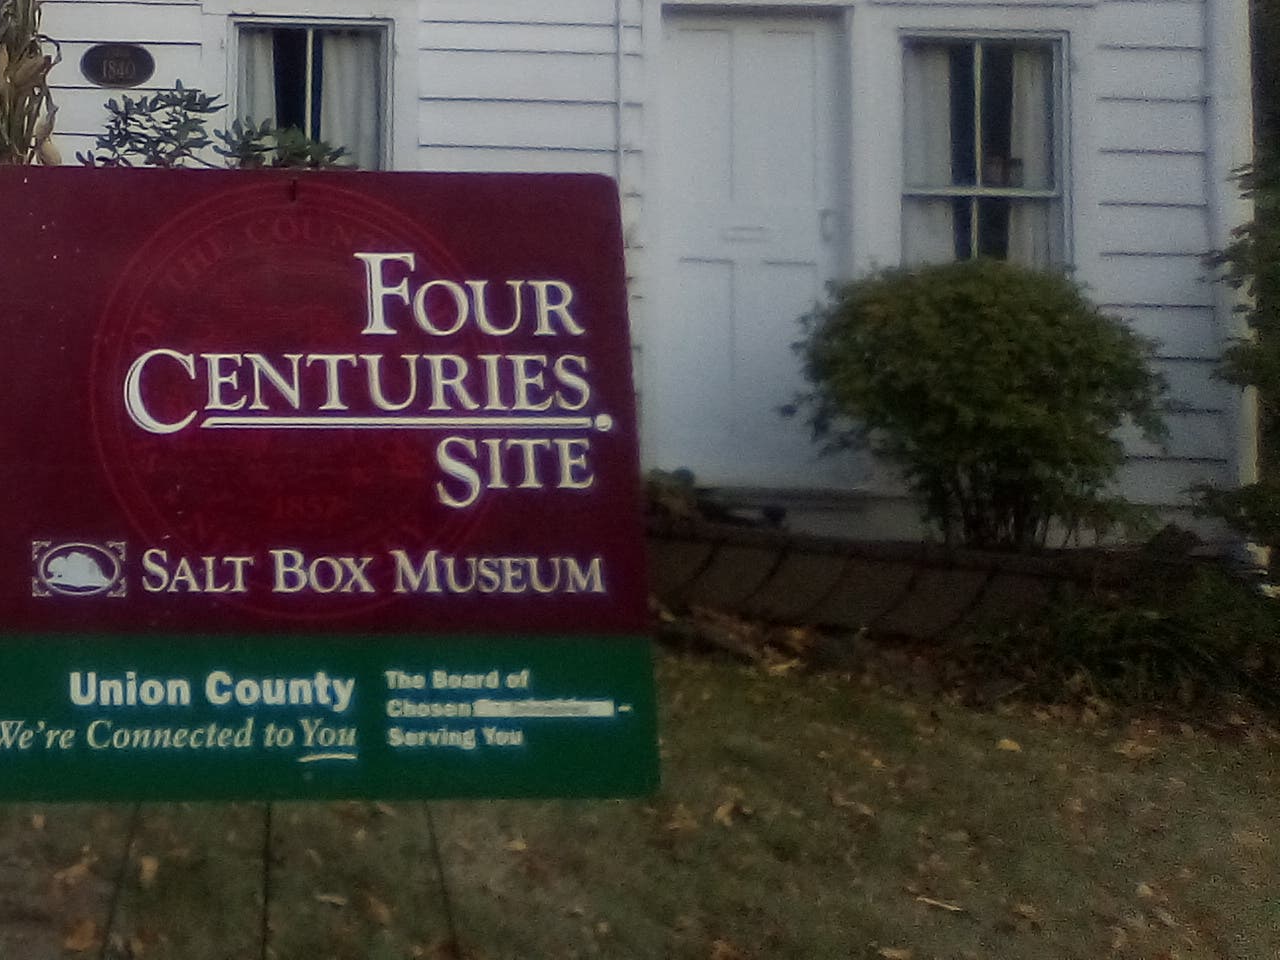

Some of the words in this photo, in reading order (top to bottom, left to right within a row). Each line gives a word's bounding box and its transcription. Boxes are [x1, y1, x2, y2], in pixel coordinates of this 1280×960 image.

[245, 214, 382, 253] COUNT
[353, 252, 585, 337] FOUR
[123, 348, 591, 434] CENTURIES
[436, 435, 594, 508] SITE
[142, 548, 254, 593] SALT
[269, 549, 375, 594] BOX
[390, 549, 604, 593] MUSEUM
[69, 670, 192, 707] Union
[204, 670, 356, 714] County
[384, 670, 427, 690] The
[431, 669, 500, 690] Board
[503, 668, 530, 690] of
[86, 716, 255, 750] Connected
[263, 722, 295, 748] to
[299, 717, 357, 747] You
[386, 725, 477, 751] Serving
[481, 725, 524, 746] You
